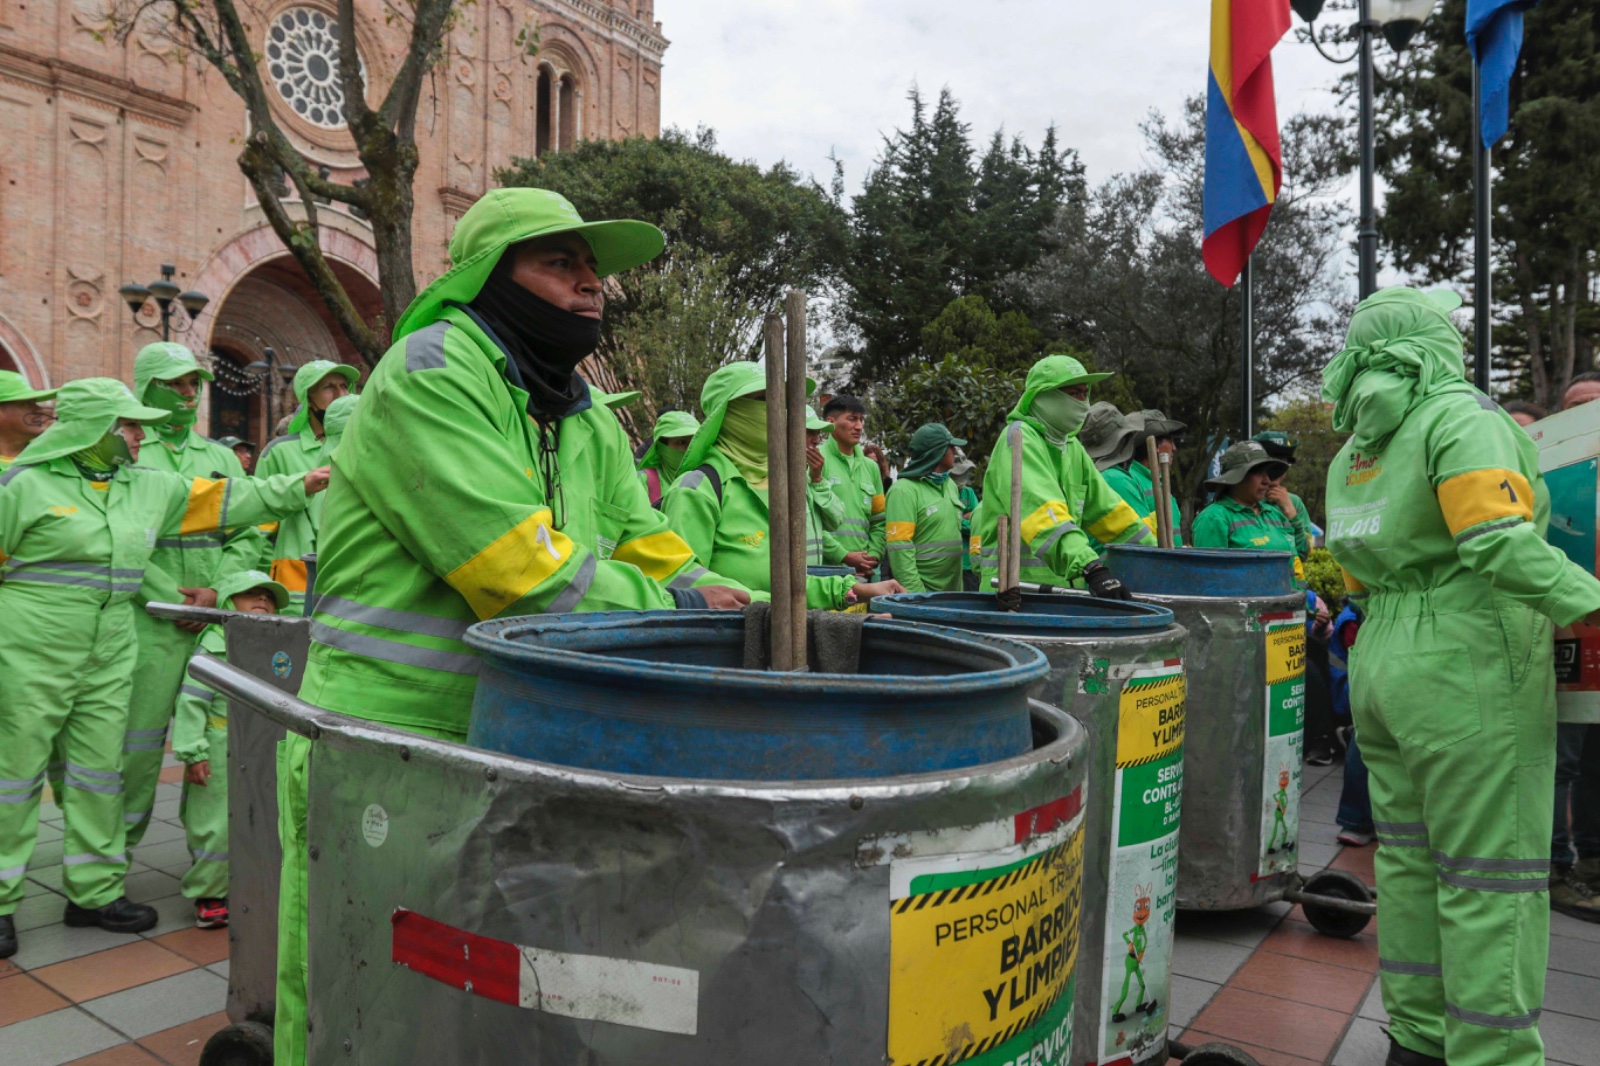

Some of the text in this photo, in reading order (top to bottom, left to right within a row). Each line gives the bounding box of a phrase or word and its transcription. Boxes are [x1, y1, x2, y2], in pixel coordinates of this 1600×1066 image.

[1500, 479, 1518, 503] 1
[535, 523, 561, 560] 1
[1136, 690, 1179, 710] PERSONAL
[1150, 845, 1163, 859] La
[935, 886, 1047, 946] PERSONAL
[1000, 874, 1081, 974] BARRIDO
